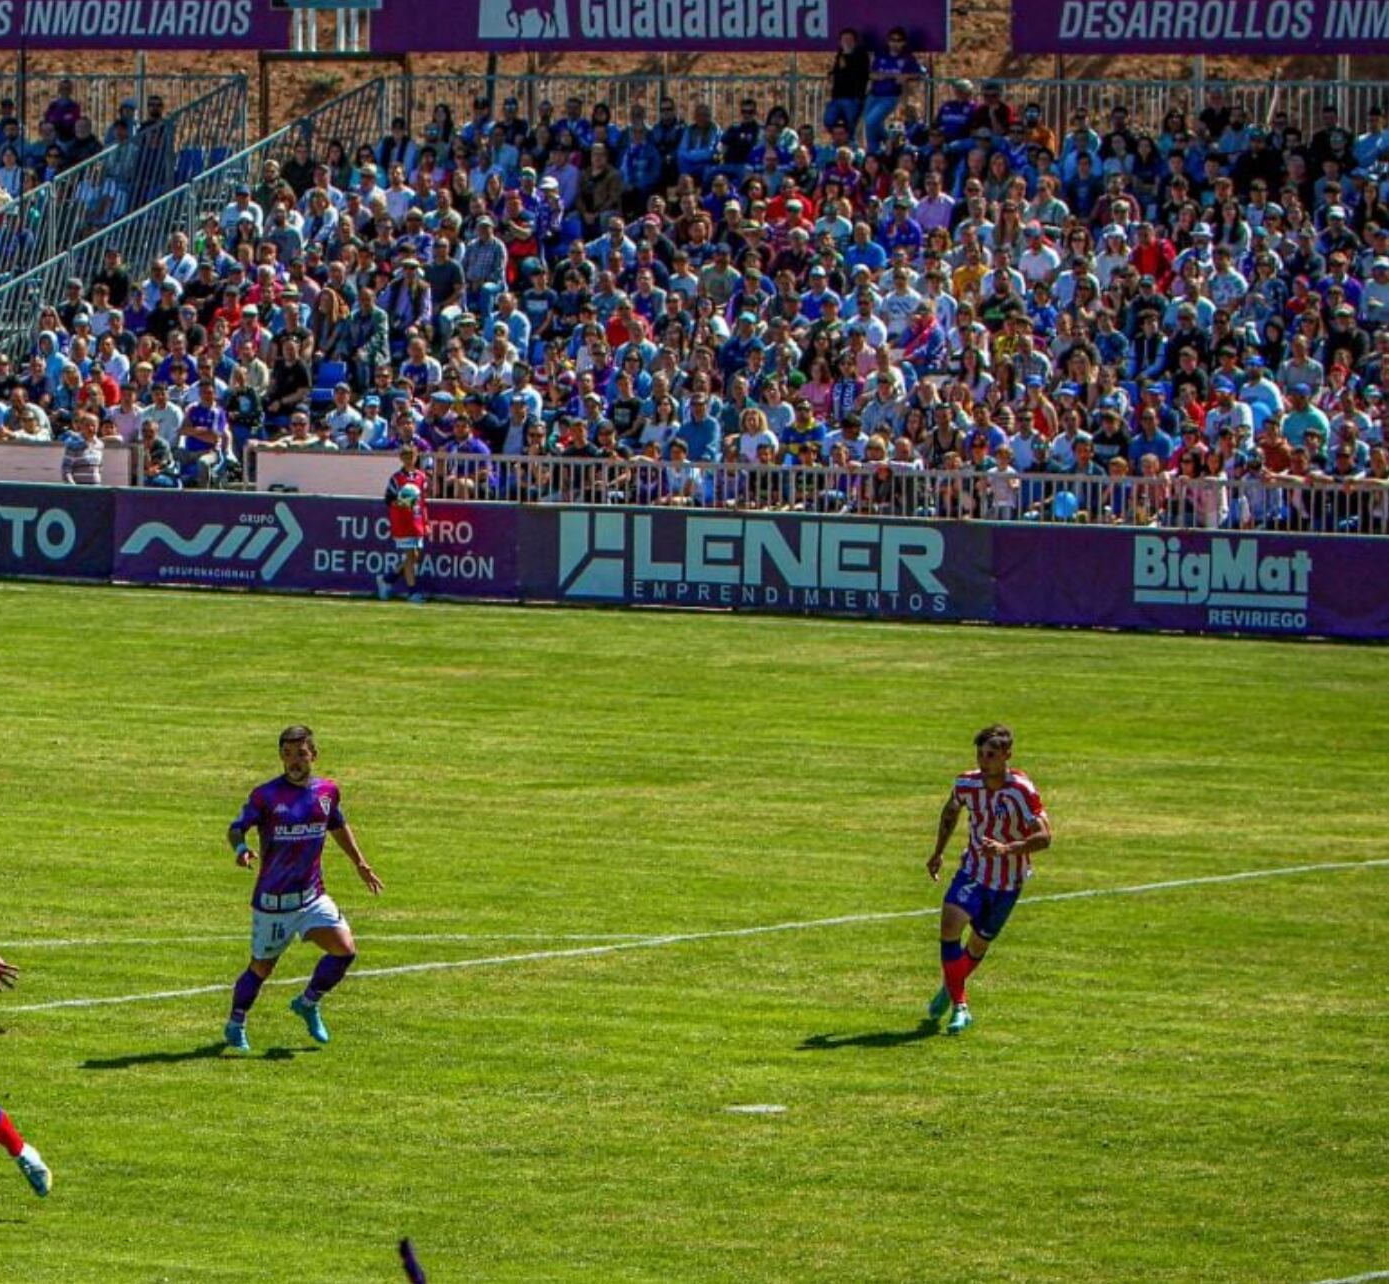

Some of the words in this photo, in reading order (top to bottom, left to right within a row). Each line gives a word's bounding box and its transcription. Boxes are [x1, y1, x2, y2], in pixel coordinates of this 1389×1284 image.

[22, 0, 252, 36] INMOBILIARIOS
[1059, 1, 1314, 39] DESARROLLOS
[238, 513, 275, 525] GRUPO
[336, 516, 368, 540] TU
[374, 517, 474, 545] CTRO
[313, 549, 347, 573] DE
[351, 550, 495, 581] FORACIÓN
[633, 513, 949, 596] LENER
[1133, 535, 1312, 605] BigMat
[632, 580, 947, 613] EMPRENDIMIENTOS
[1208, 608, 1308, 629] REVIRIEGO
